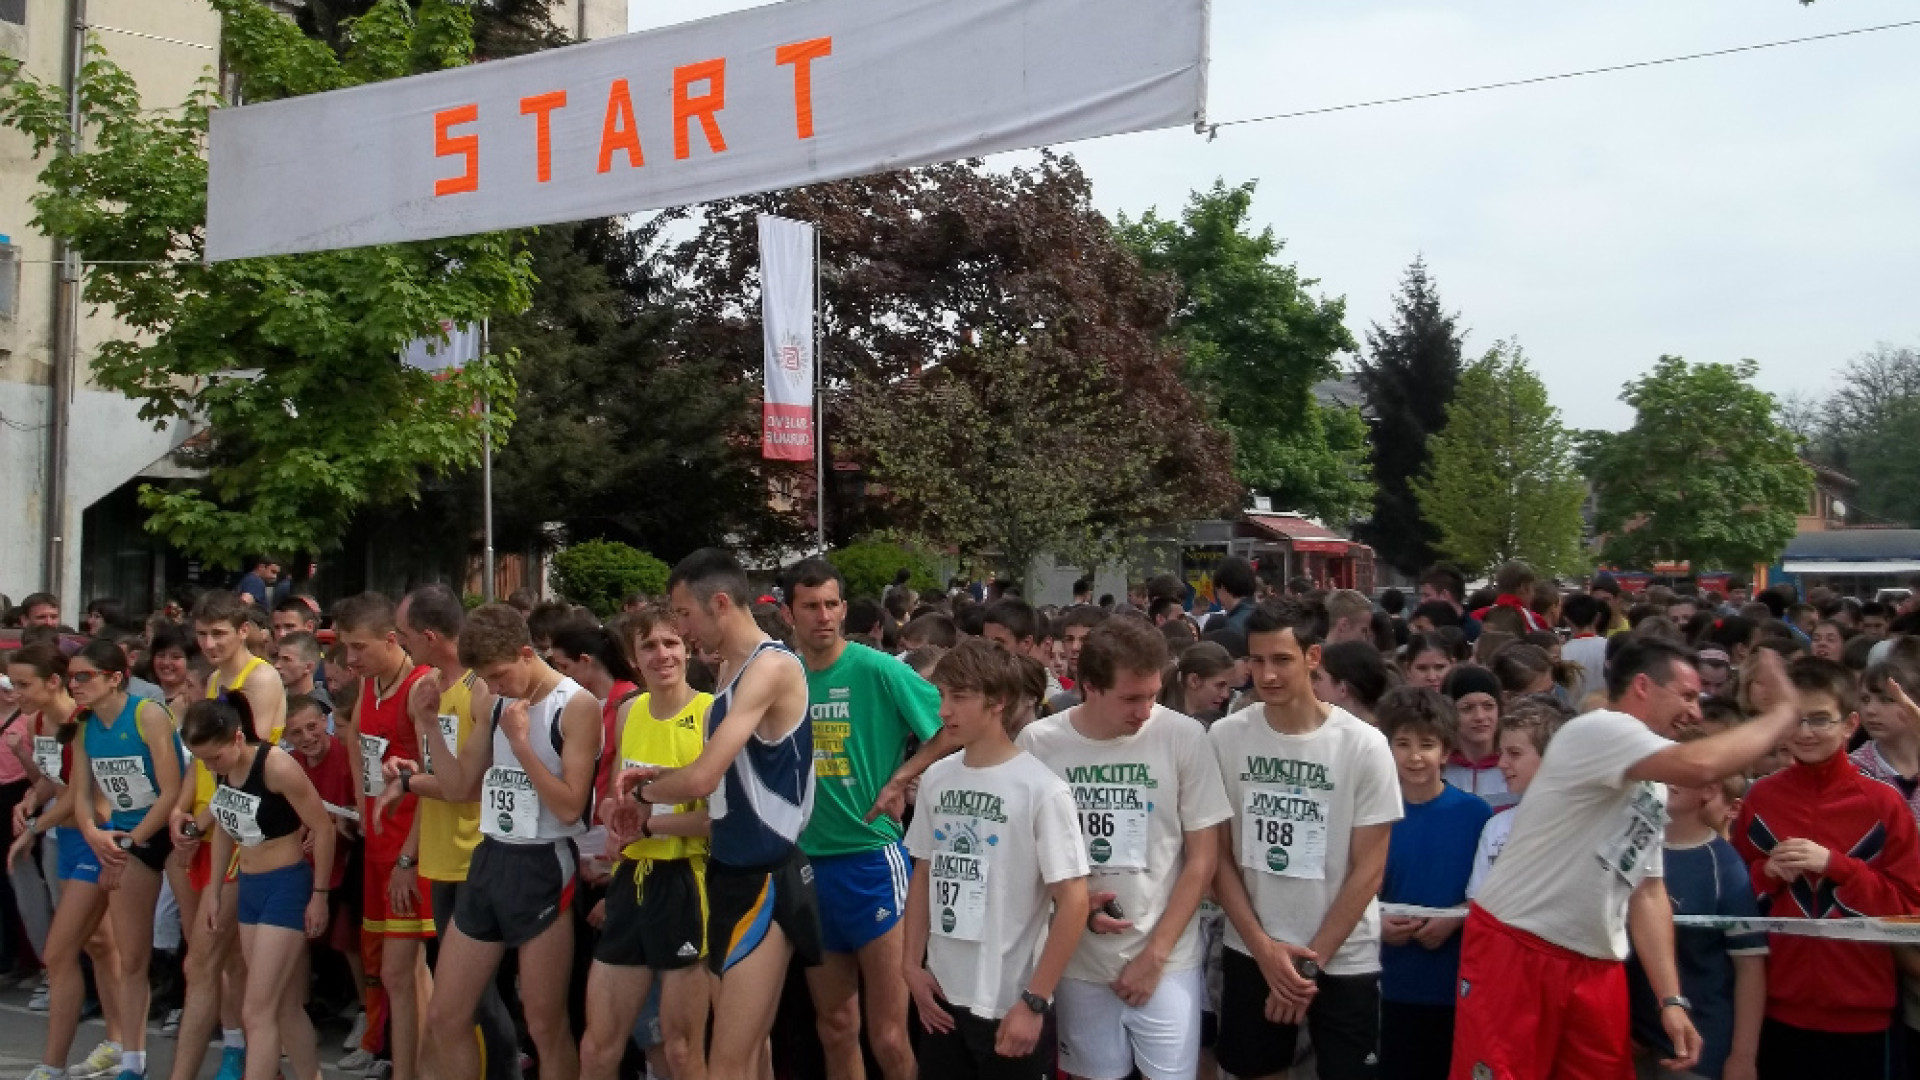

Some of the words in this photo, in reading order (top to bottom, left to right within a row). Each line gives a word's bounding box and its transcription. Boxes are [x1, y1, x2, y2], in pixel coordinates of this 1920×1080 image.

[435, 37, 832, 197] START
[103, 777, 129, 793] 189
[489, 790, 515, 811] 193
[1078, 811, 1115, 837] 186
[1255, 818, 1295, 846] 188
[936, 880, 960, 906] 187
